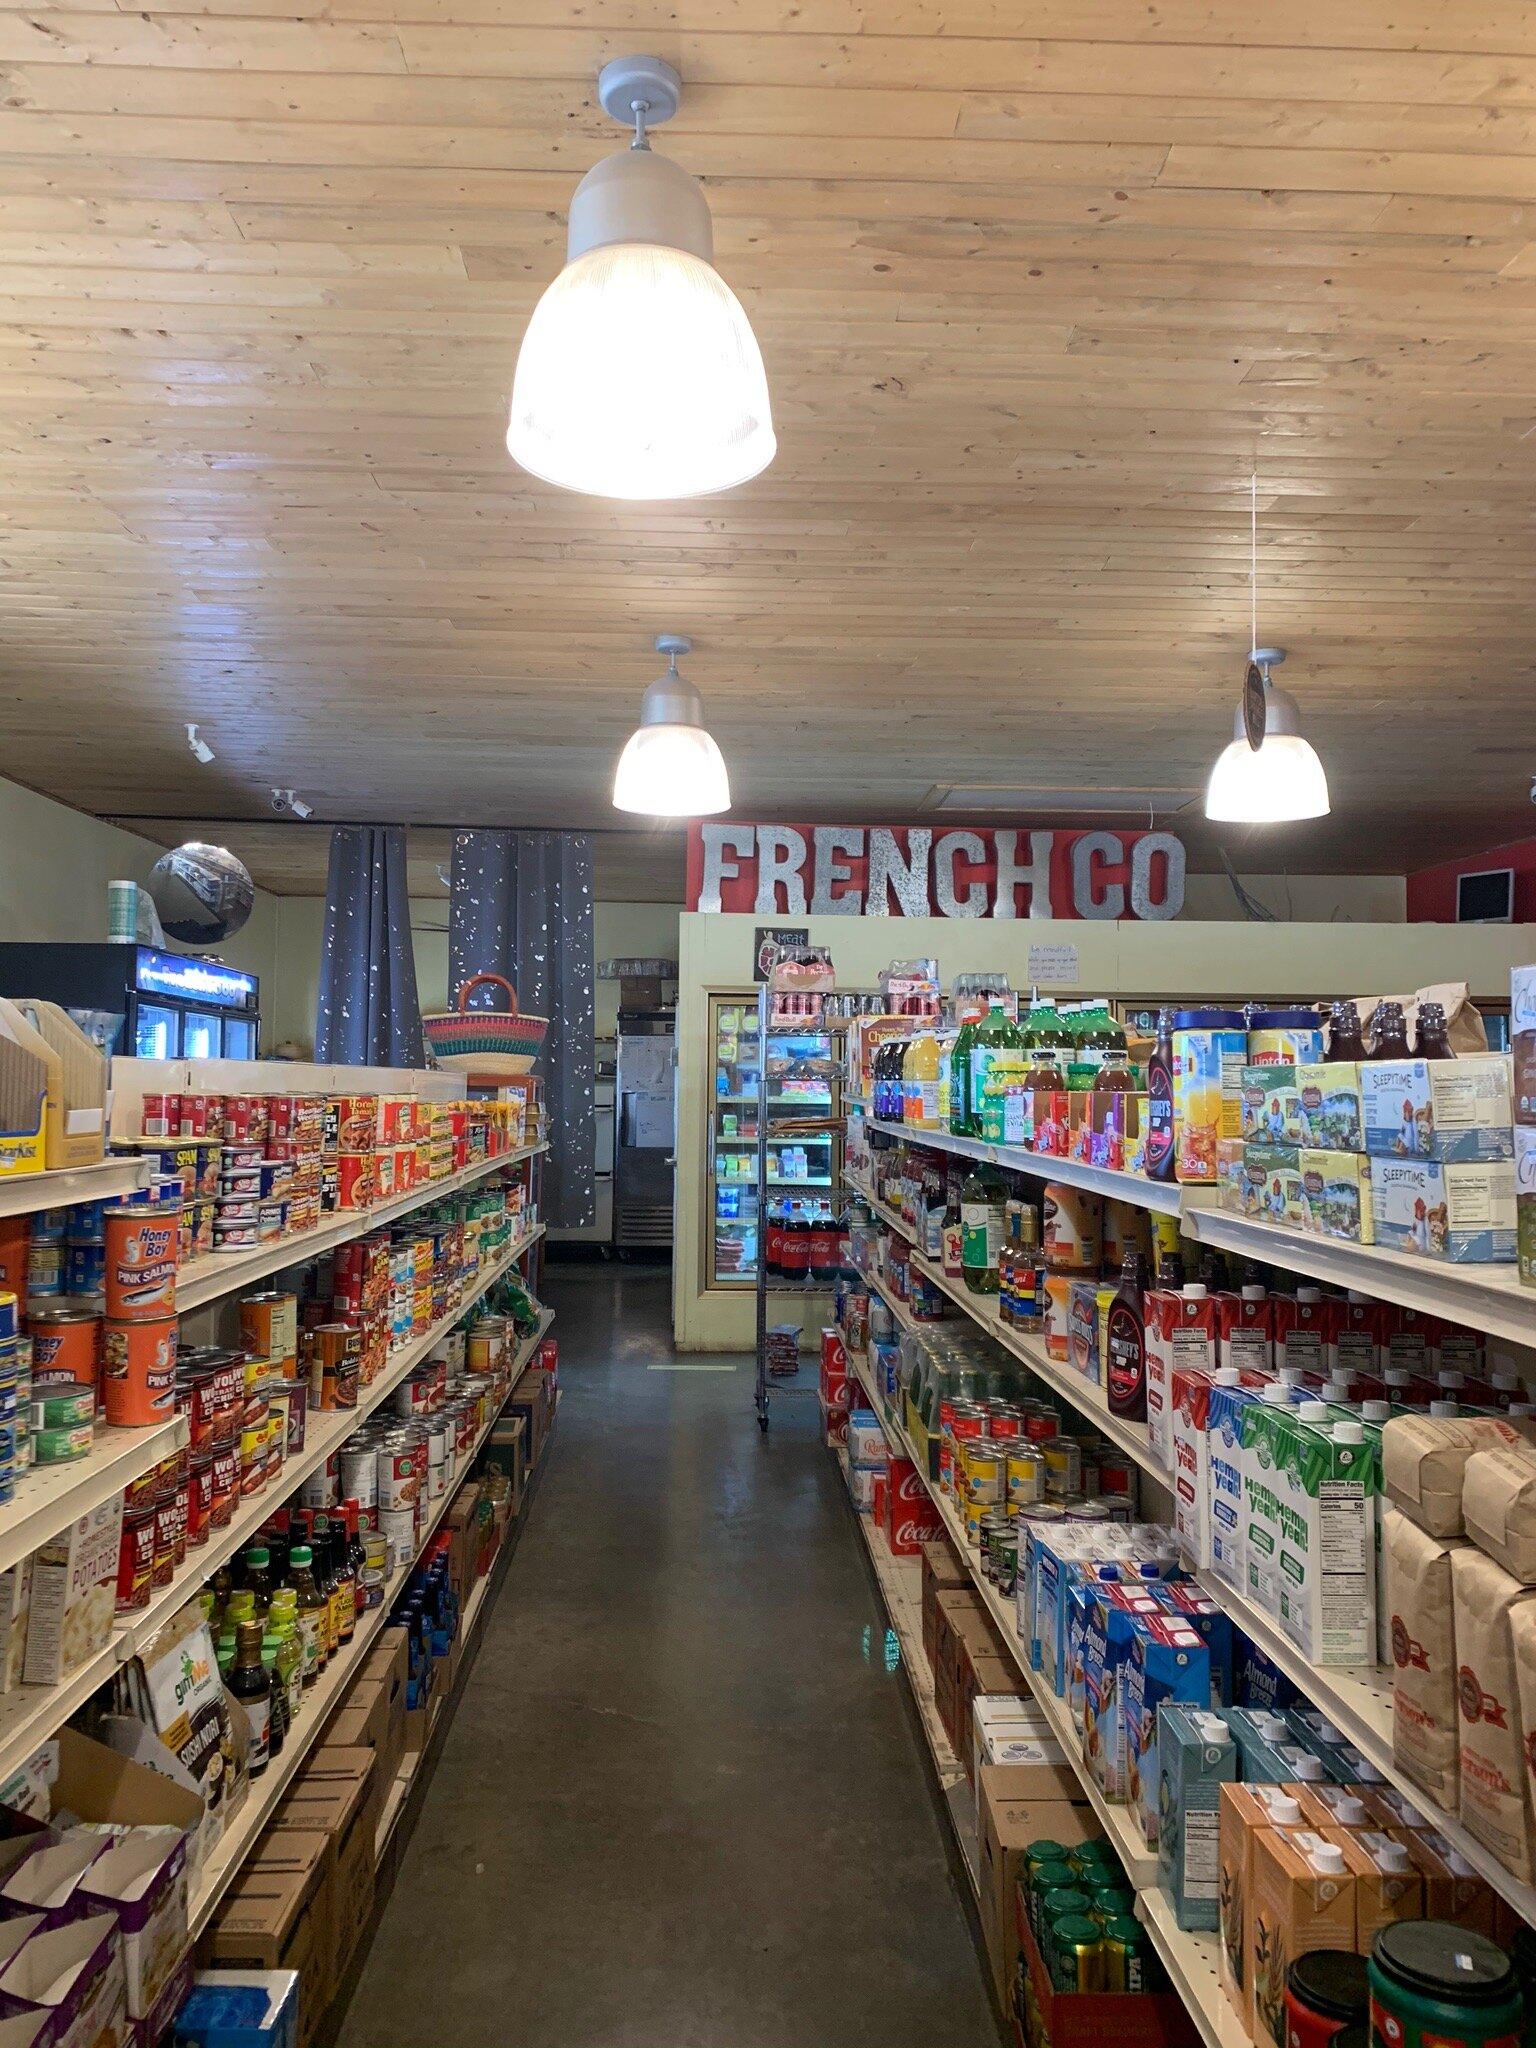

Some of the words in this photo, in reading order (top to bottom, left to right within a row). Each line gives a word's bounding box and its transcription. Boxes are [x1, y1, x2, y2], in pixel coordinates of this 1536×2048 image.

[698, 824, 1053, 919] FRENCH
[1072, 830, 1187, 921] CO
[1254, 1056, 1291, 1065] Lipton
[1373, 1073, 1413, 1089] SLEEPYTIME
[1181, 1158, 1198, 1169] 30
[1383, 1168, 1426, 1188] SLEEPYTIME
[139, 1227, 172, 1243] Honey
[145, 1242, 168, 1258] Boy
[118, 1268, 142, 1284] PINK
[1110, 1337, 1139, 1361] SHEY'S
[148, 1374, 168, 1386] PINK
[1210, 1454, 1240, 1482] Hemp
[1244, 1475, 1278, 1508] Hemp
[1277, 1499, 1308, 1538] Hemp
[72, 1544, 119, 1593] POTATOES
[1125, 1658, 1146, 1691] Almond
[1243, 1659, 1278, 1698] Almond
[1250, 1686, 1273, 1708] Breeze
[181, 1733, 202, 1768] SUSHI
[201, 1716, 220, 1746] NORI
